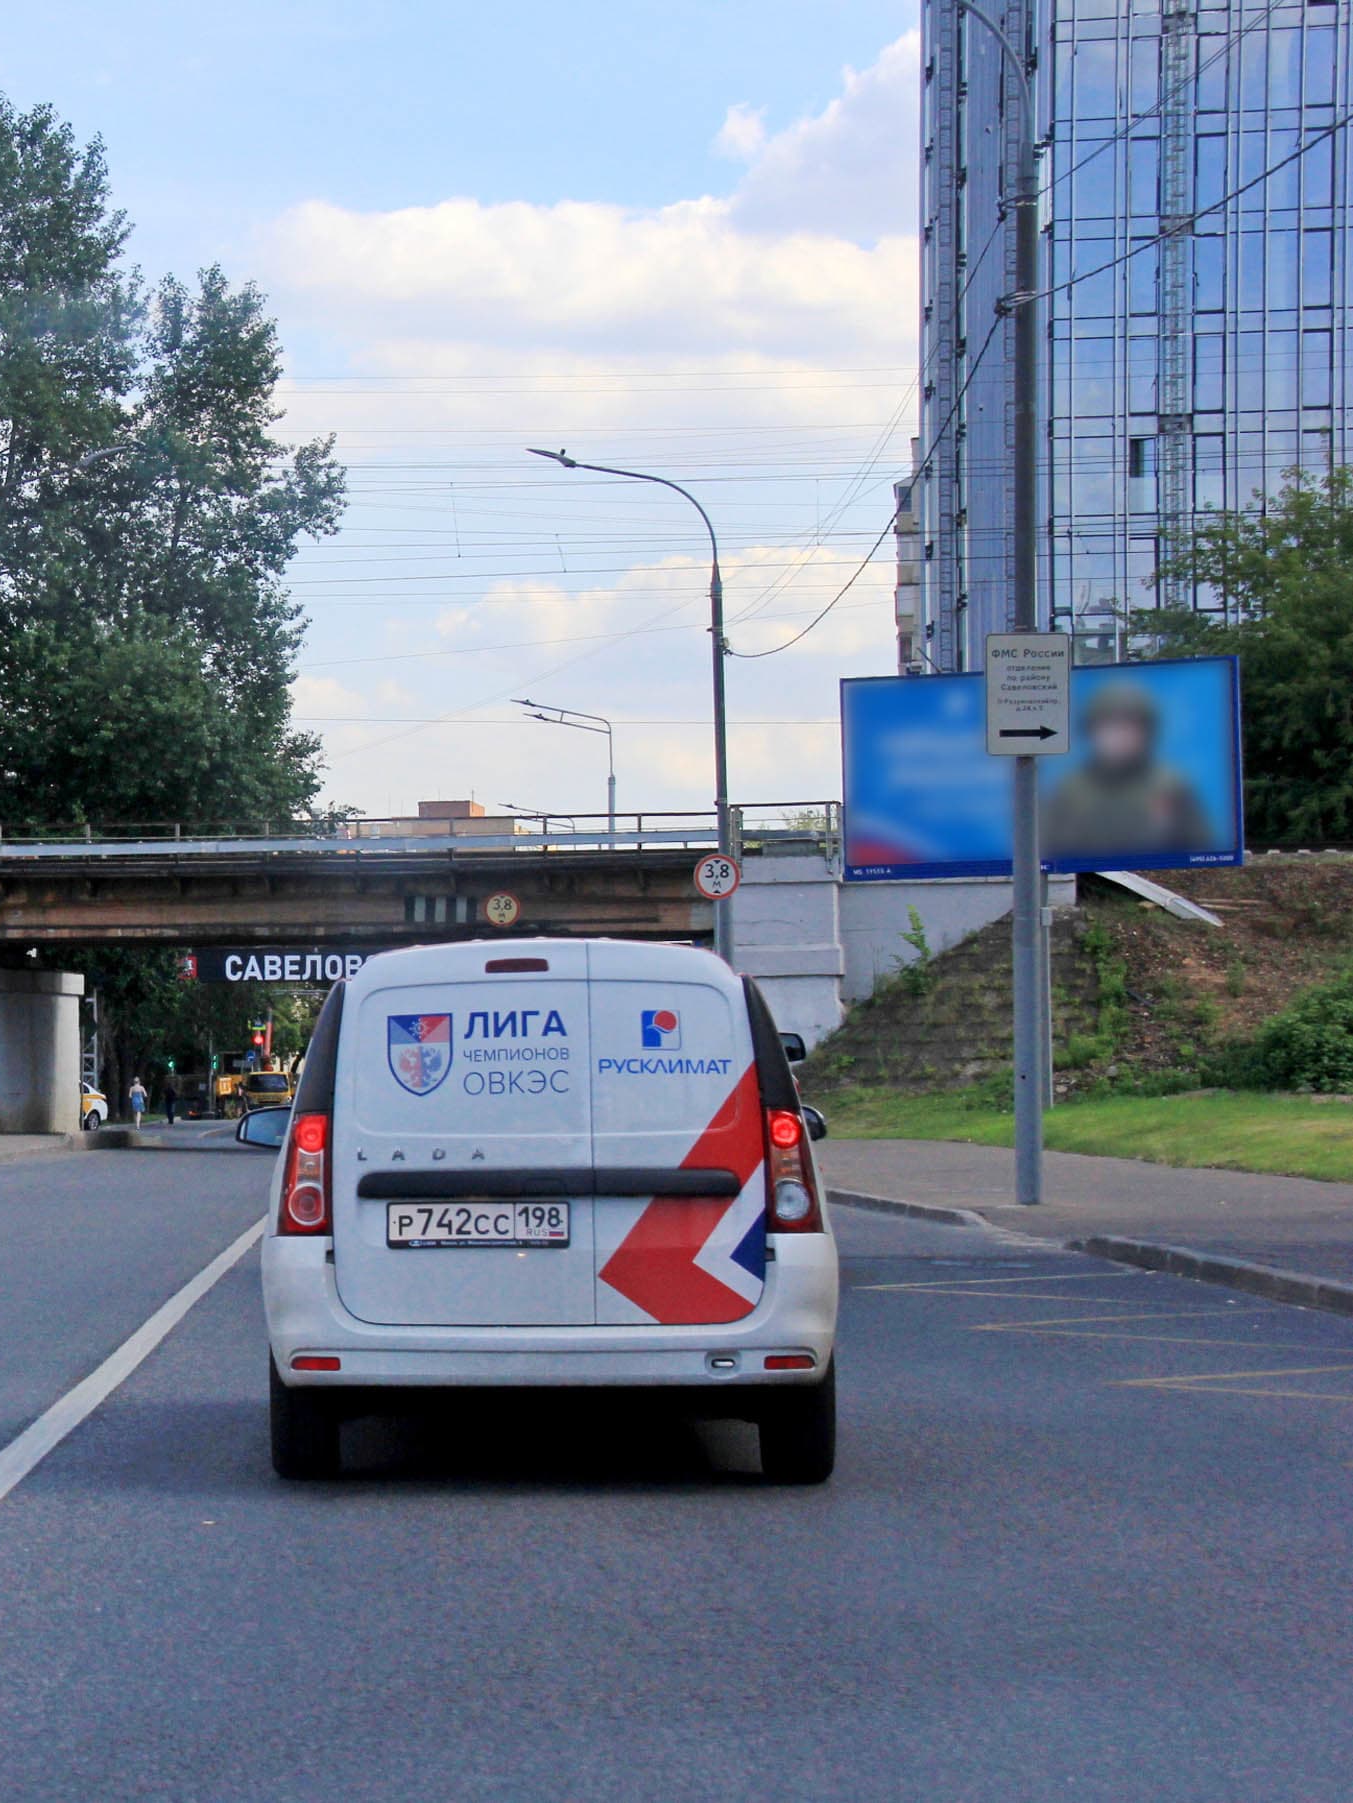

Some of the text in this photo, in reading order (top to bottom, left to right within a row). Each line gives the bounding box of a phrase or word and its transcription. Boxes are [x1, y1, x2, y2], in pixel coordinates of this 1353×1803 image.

[991, 648, 1065, 658] ФМС России
[705, 864, 730, 880] 3,8
[492, 899, 513, 911] 3,8
[225, 954, 372, 982] САВЕЛОВ
[463, 1010, 568, 1040] ЛИГА
[463, 1047, 569, 1063] ЧЕМПИОНОВ
[598, 1058, 733, 1075] РУСКЛИМАТ
[463, 1069, 570, 1096] ОВКЭС
[357, 1146, 486, 1161] LADA
[518, 1206, 561, 1229] 198
[526, 1228, 548, 1237] RUS
